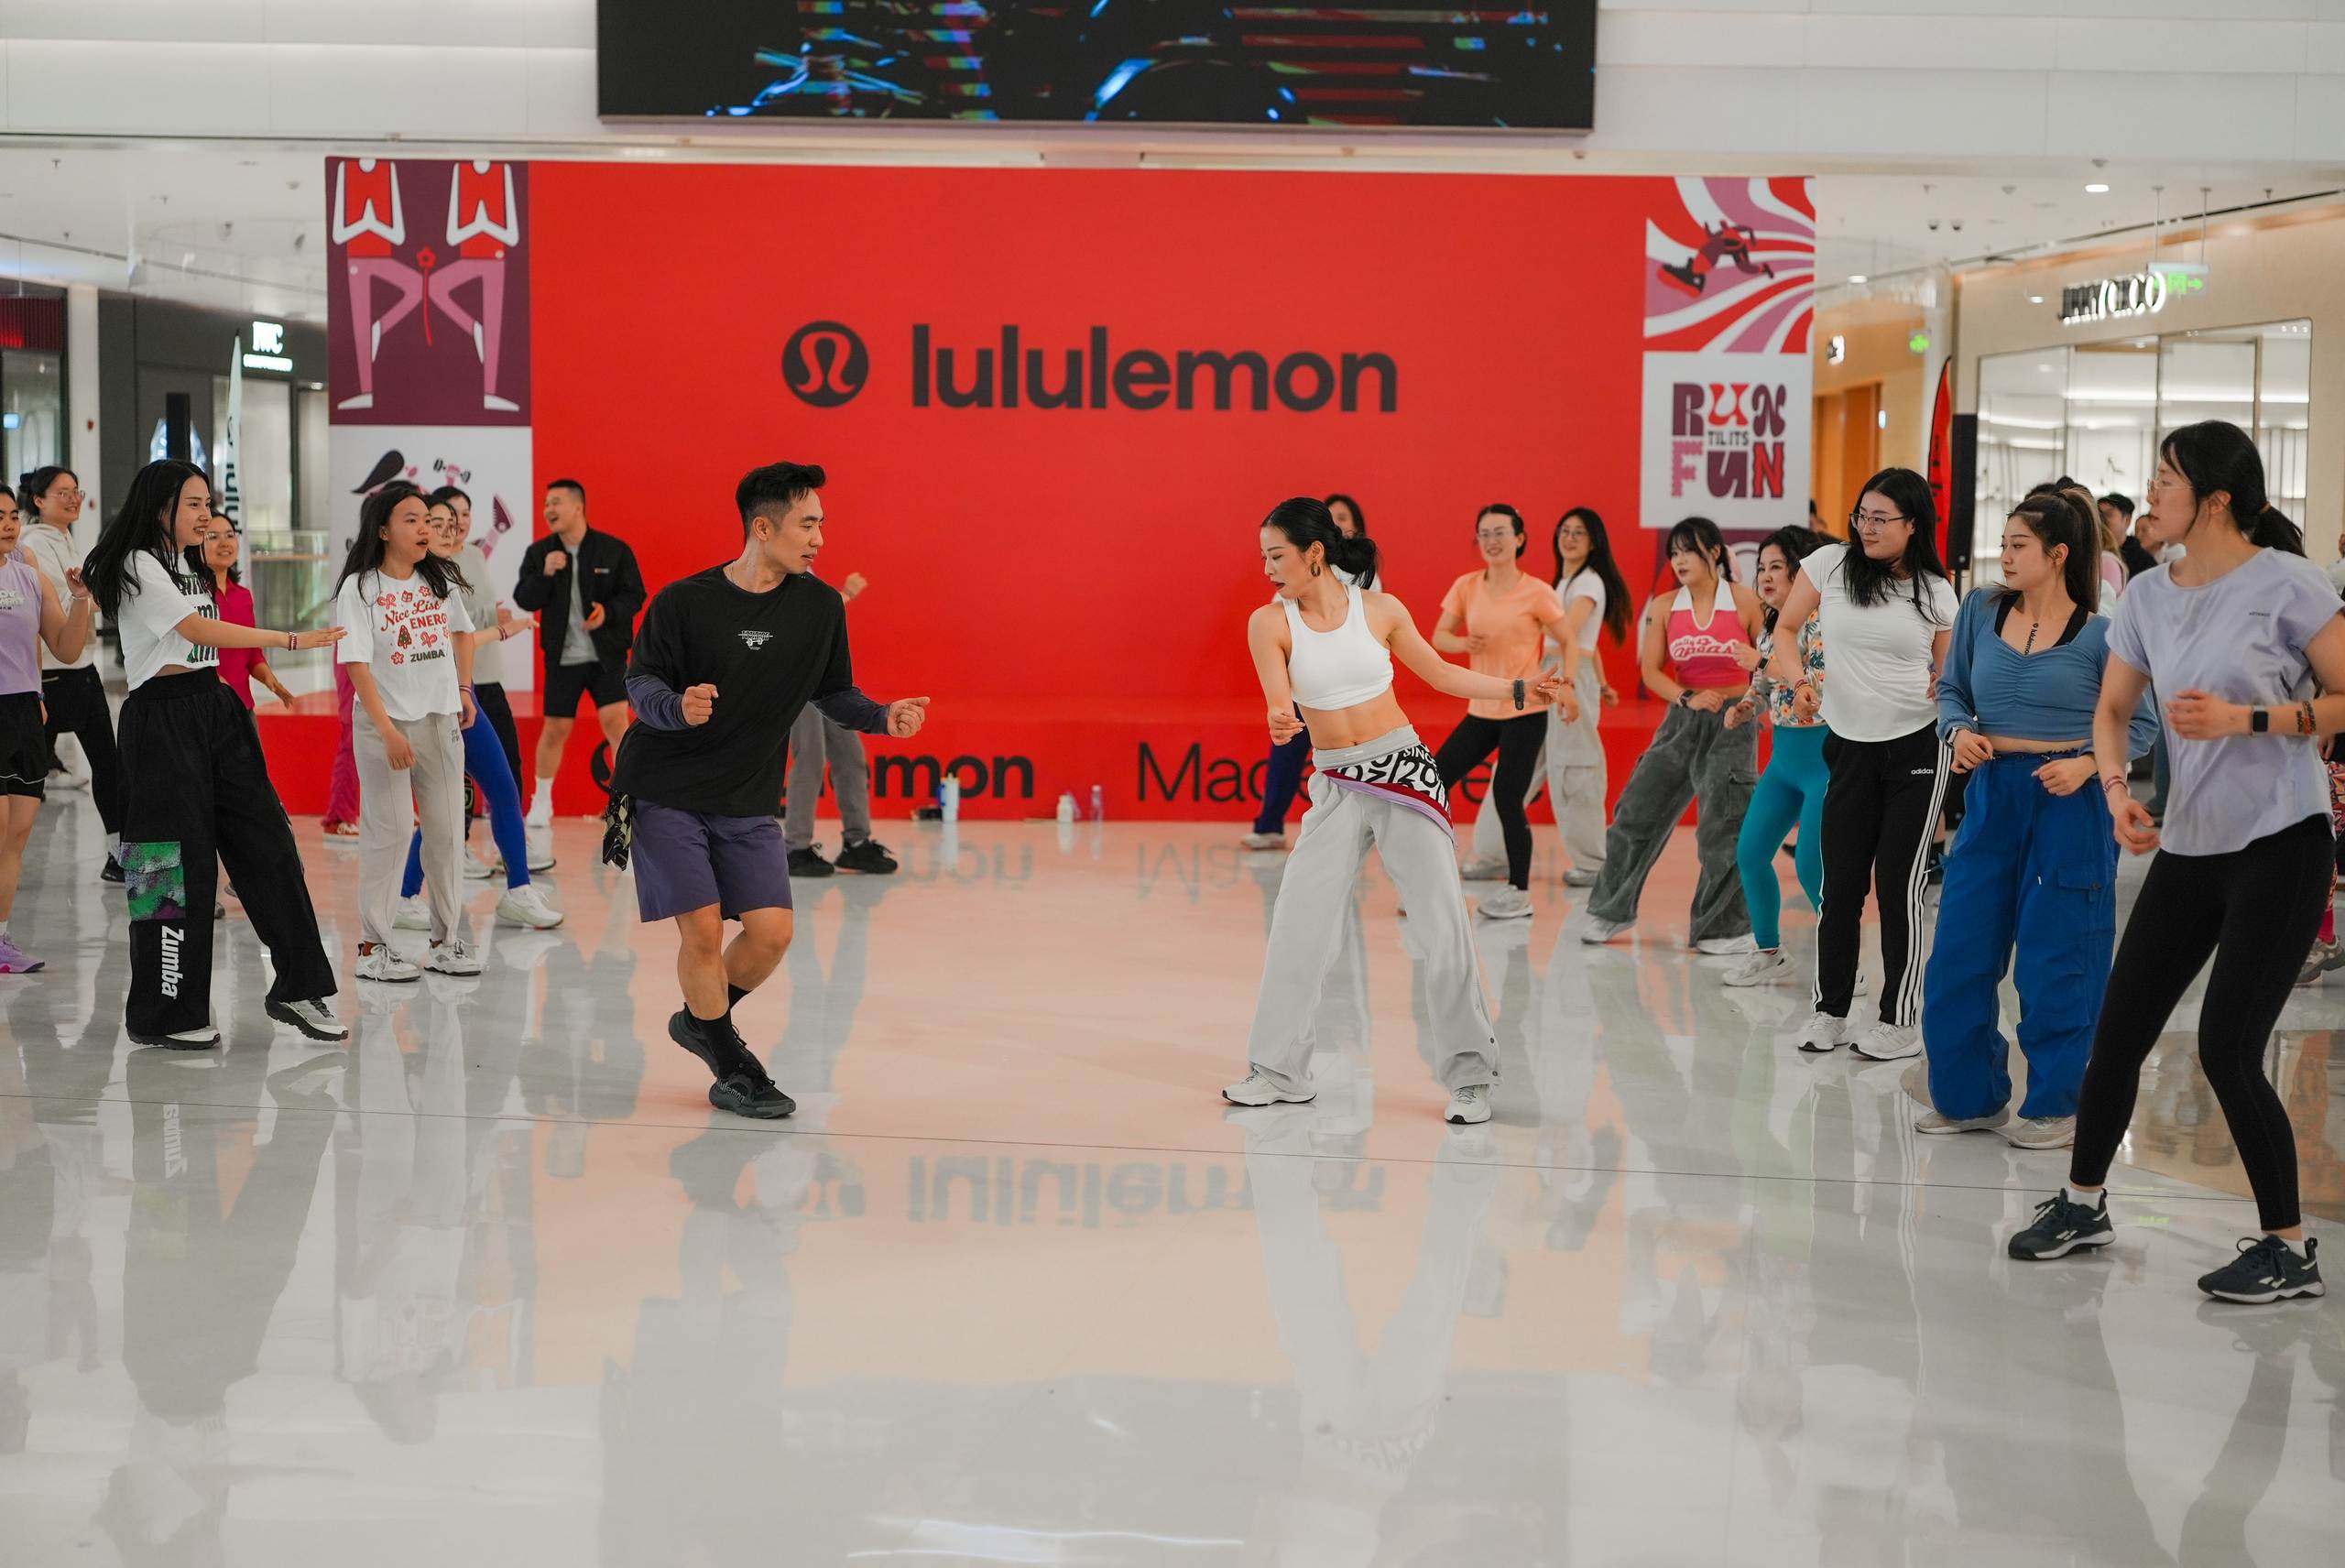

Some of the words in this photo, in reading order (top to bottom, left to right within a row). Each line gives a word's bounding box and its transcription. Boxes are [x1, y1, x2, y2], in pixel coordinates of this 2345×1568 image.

[912, 323, 1398, 412] lululemon
[1672, 383, 1786, 437] RUN
[1672, 441, 1784, 498] FUN
[380, 609, 410, 632] Nice
[411, 600, 442, 615] List
[409, 613, 447, 630] ENERG
[410, 648, 445, 662] ZUMBA
[1402, 746, 1436, 766] SINC
[161, 926, 184, 997] Zumba
